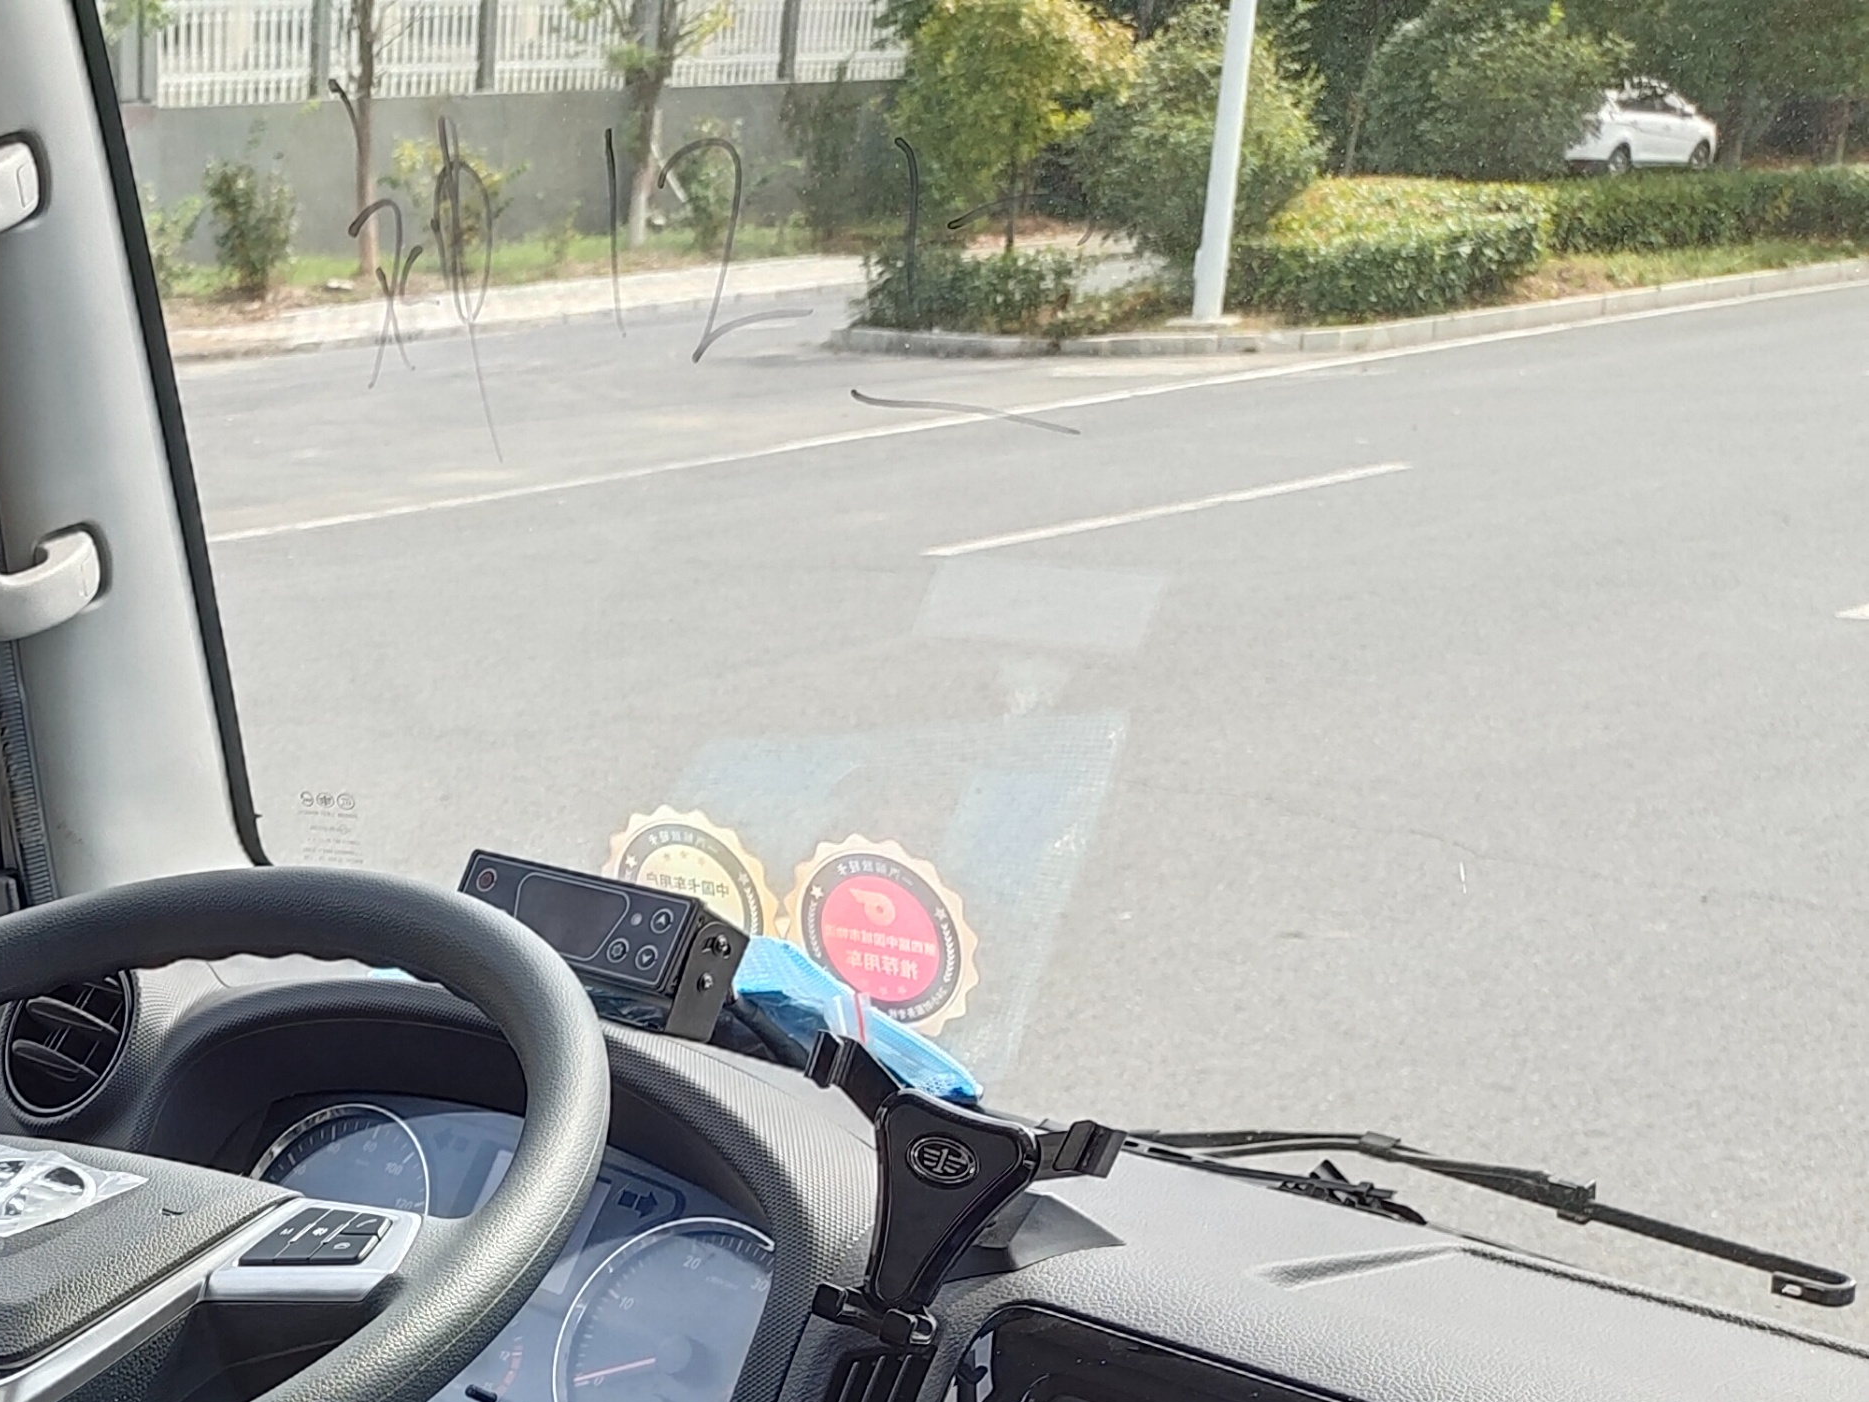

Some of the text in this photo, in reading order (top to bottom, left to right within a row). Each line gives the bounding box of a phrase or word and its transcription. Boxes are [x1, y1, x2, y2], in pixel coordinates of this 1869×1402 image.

[384, 1161, 403, 1177] 100
[395, 1197, 413, 1211] 120
[683, 1255, 702, 1270] 20
[750, 1277, 769, 1292] 30
[619, 1296, 635, 1311] 10
